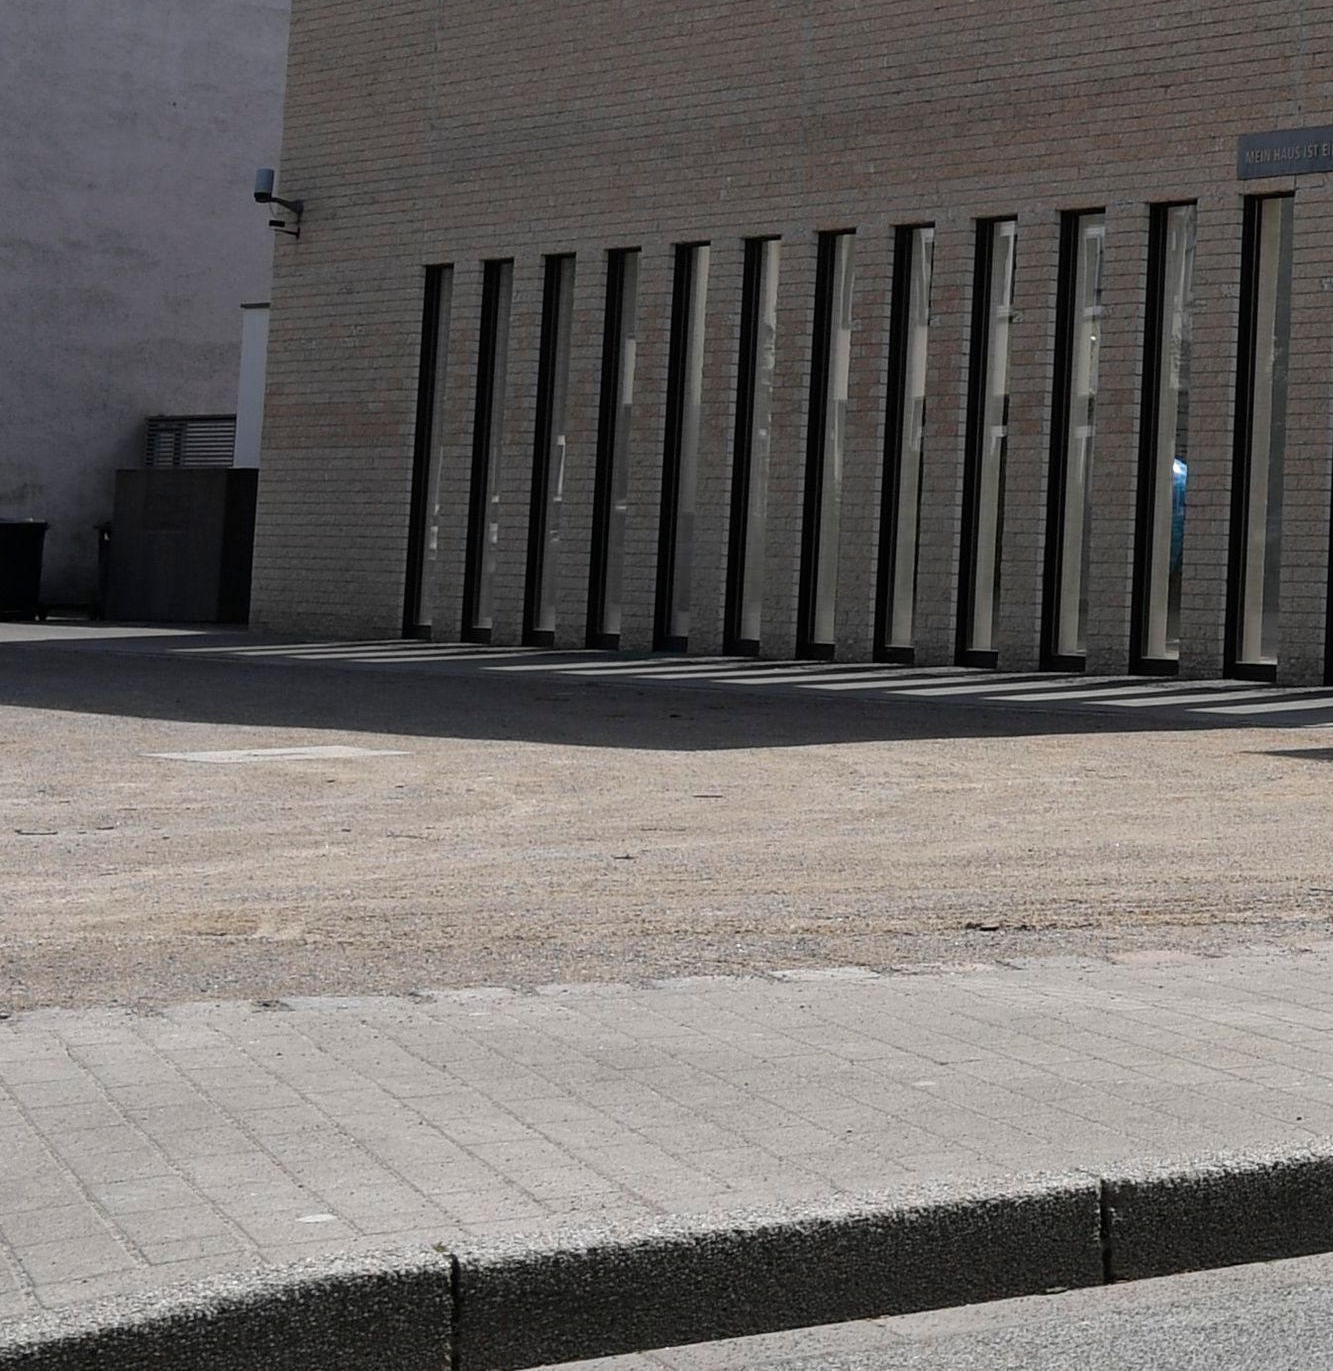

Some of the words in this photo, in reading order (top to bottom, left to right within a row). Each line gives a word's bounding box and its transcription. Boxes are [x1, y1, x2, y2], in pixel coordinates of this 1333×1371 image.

[1246, 149, 1271, 163] MEIN
[1273, 146, 1300, 160] HAUS
[1303, 144, 1319, 158] IST
